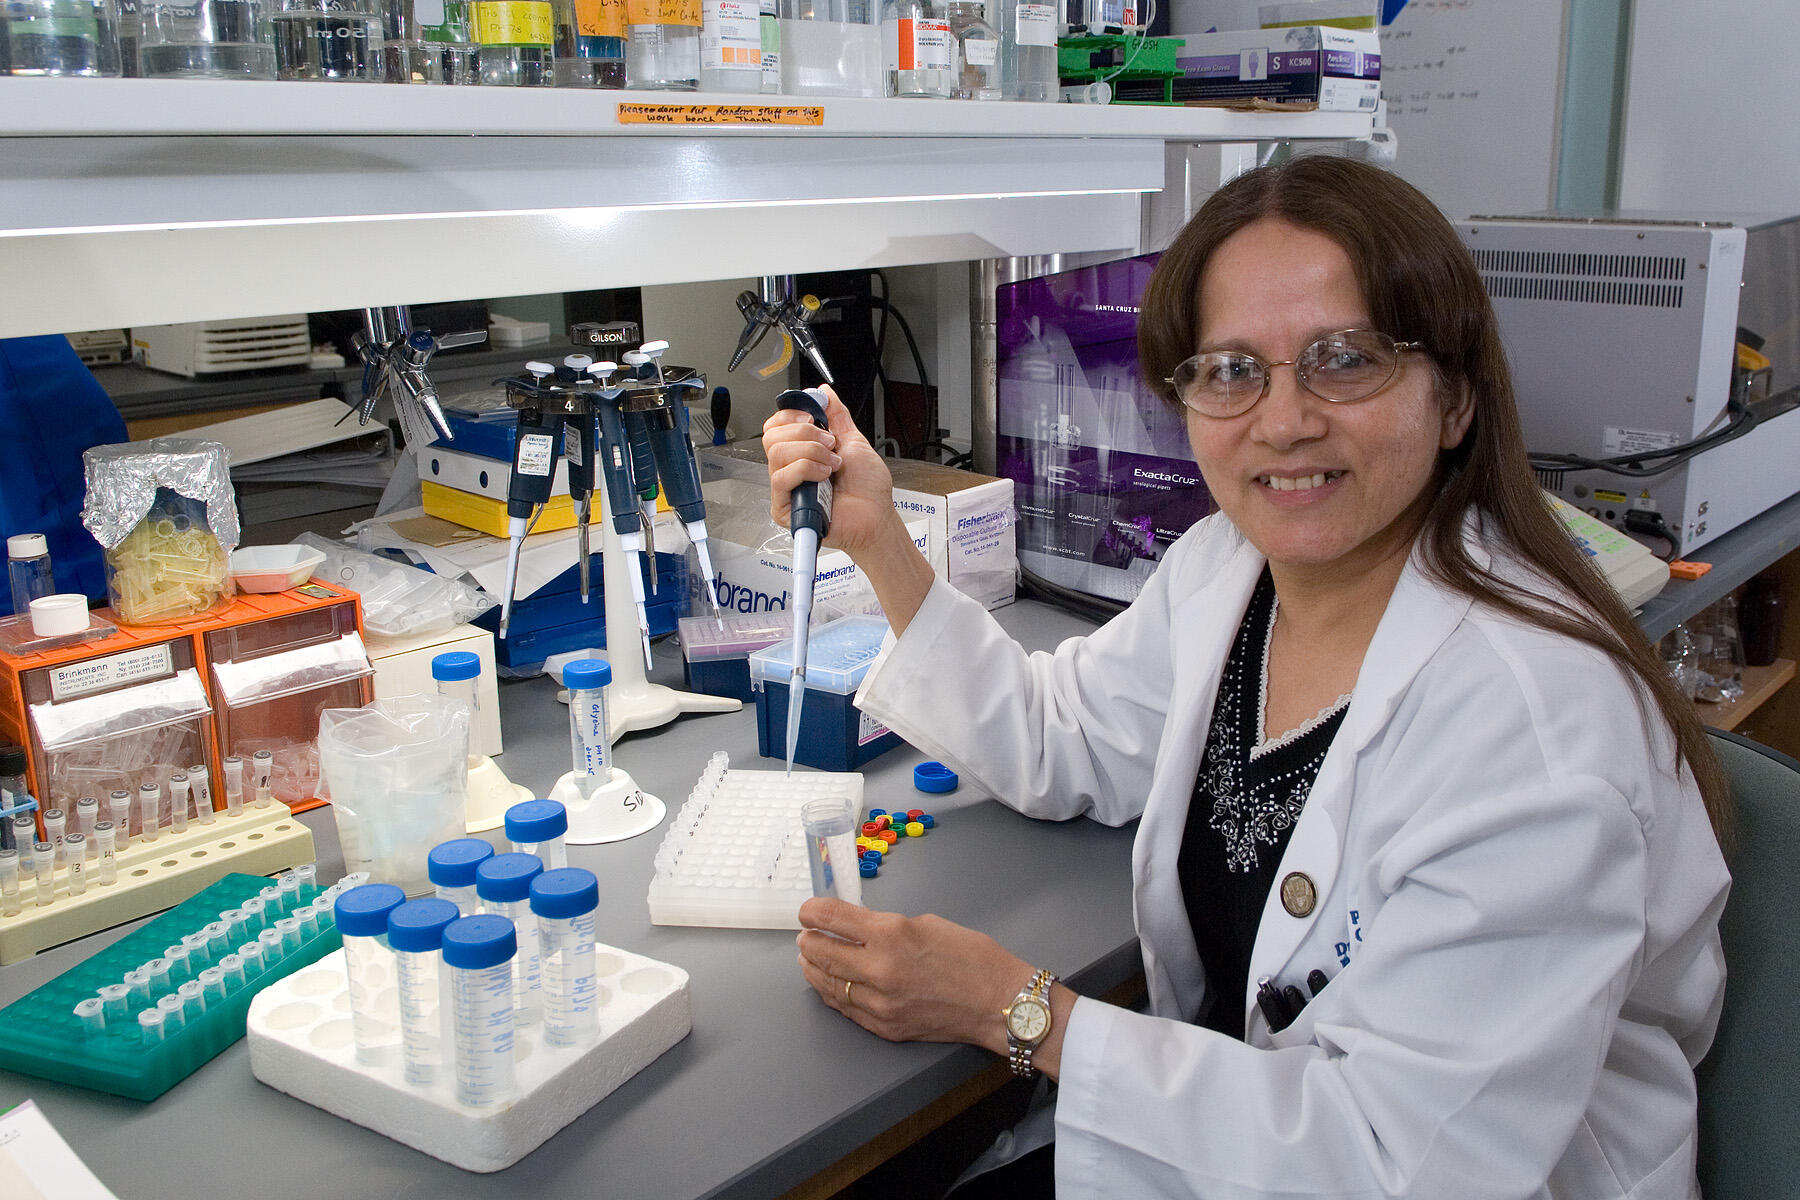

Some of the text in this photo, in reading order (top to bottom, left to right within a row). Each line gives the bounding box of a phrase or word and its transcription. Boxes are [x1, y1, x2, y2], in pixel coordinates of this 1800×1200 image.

[1272, 56, 1281, 71] S
[1289, 57, 1312, 67] KC500
[1095, 304, 1114, 312] SANTA
[1116, 305, 1132, 313] CRUZ
[590, 333, 623, 343] GILSON
[657, 394, 665, 406] 5
[564, 400, 574, 412] 4
[1134, 468, 1196, 485] ExactaCruz
[900, 502, 936, 515] 14-961-29
[1068, 512, 1100, 522] CrystalCruz
[1112, 519, 1141, 529] ChemCruz
[815, 563, 856, 583] sherbrand
[58, 664, 108, 680] Brinkmann
[201, 788, 208, 799] 8
[121, 818, 128, 828] 5
[72, 863, 81, 873] 13
